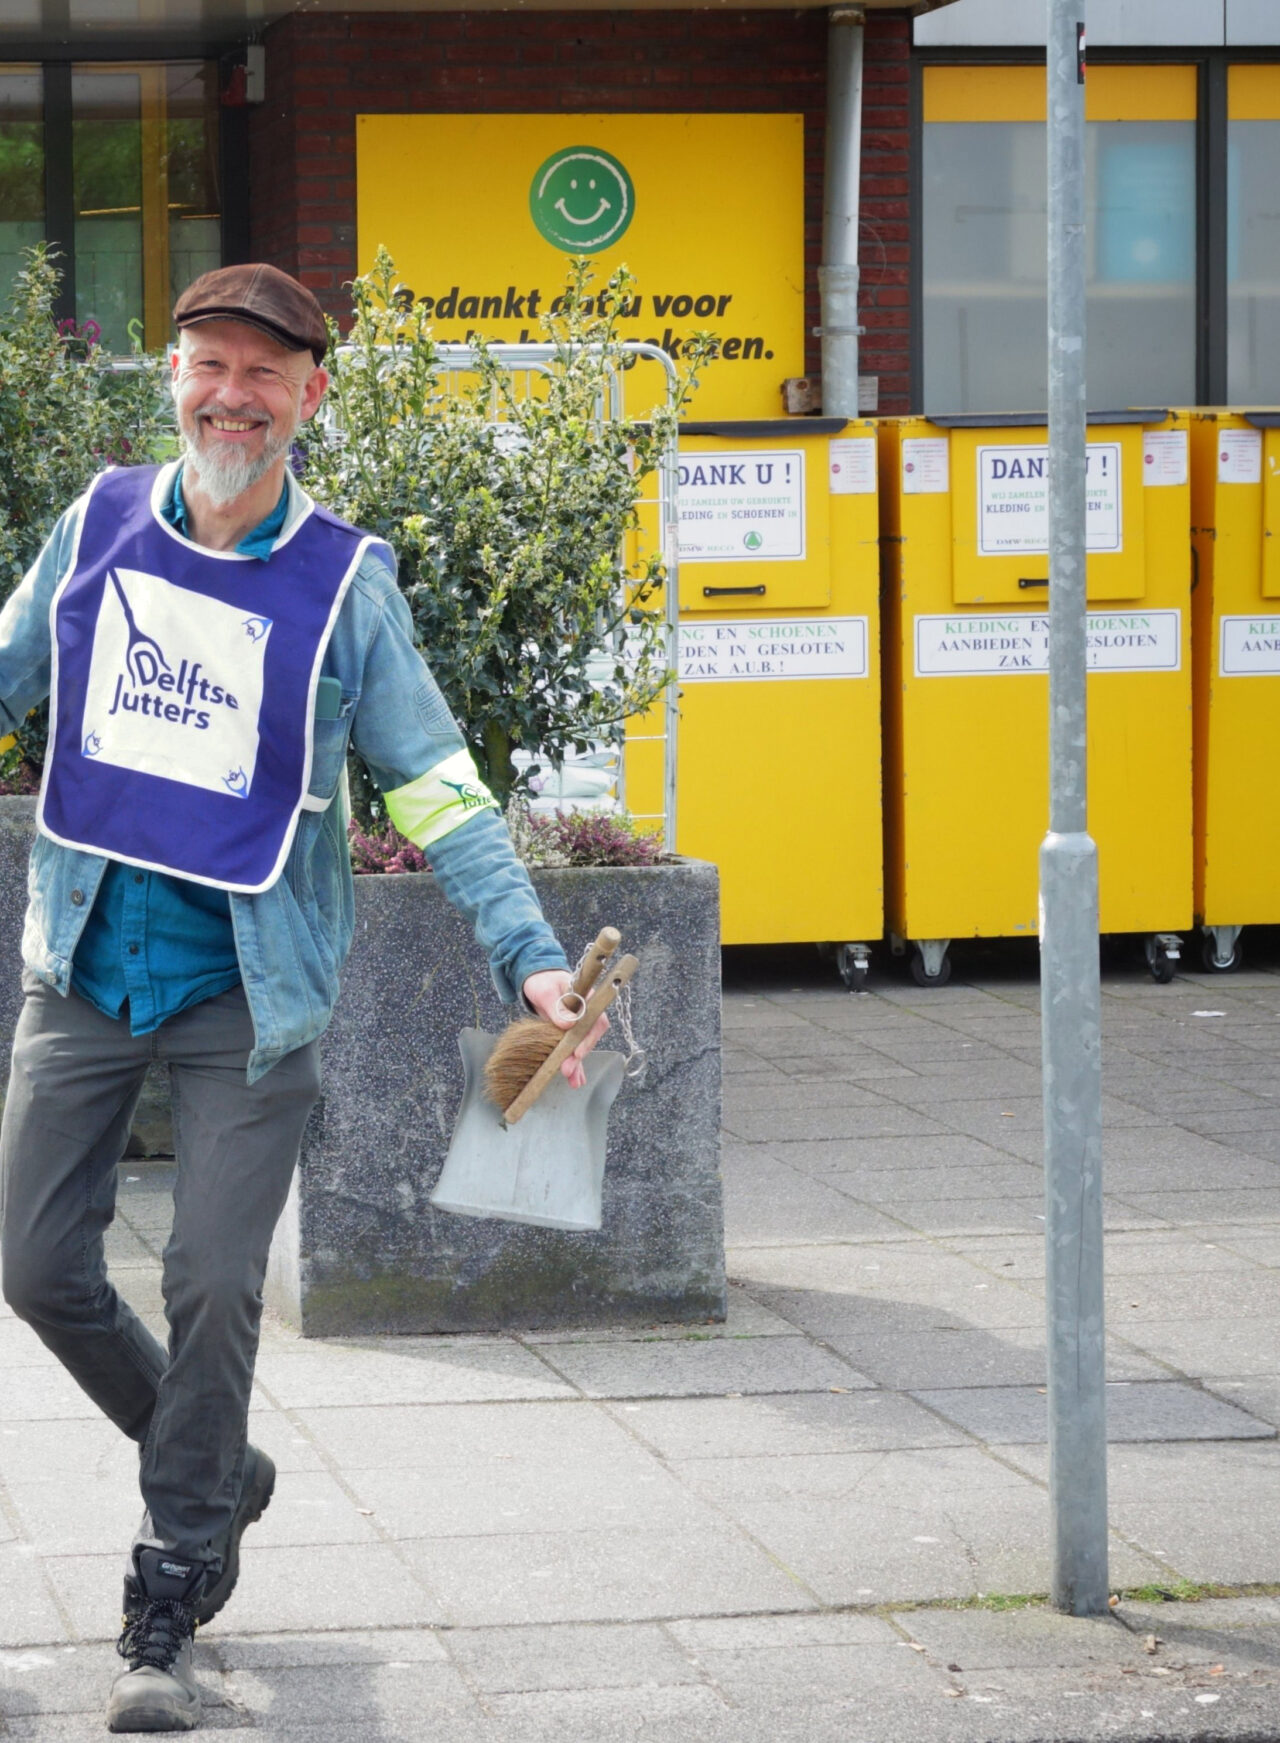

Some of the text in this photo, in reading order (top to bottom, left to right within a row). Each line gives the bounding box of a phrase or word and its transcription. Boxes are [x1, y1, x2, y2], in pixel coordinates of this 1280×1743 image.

[652, 294, 732, 318] voor
[755, 463, 774, 485] U
[785, 462, 792, 485] !
[991, 458, 1049, 479] DAN
[1102, 455, 1108, 477] !
[747, 495, 792, 505] GEBRUIKTE
[679, 510, 713, 520] EDING
[731, 509, 785, 520] SCHOENEN
[986, 503, 1031, 514] KLEDING
[716, 628, 737, 641] EN
[748, 625, 838, 640] SCHOENEN
[945, 620, 1019, 635] KLEDING
[730, 644, 747, 657] IN
[758, 641, 846, 656] GESLOTEN
[938, 637, 1032, 653] AANBIEDEN
[1086, 634, 1157, 649] ESLOTEN
[685, 663, 718, 675] ZAK
[730, 660, 774, 674] A.U.B.
[999, 654, 1032, 667] ZAK
[134, 650, 239, 709] Delftse
[109, 674, 210, 729] Jutters
